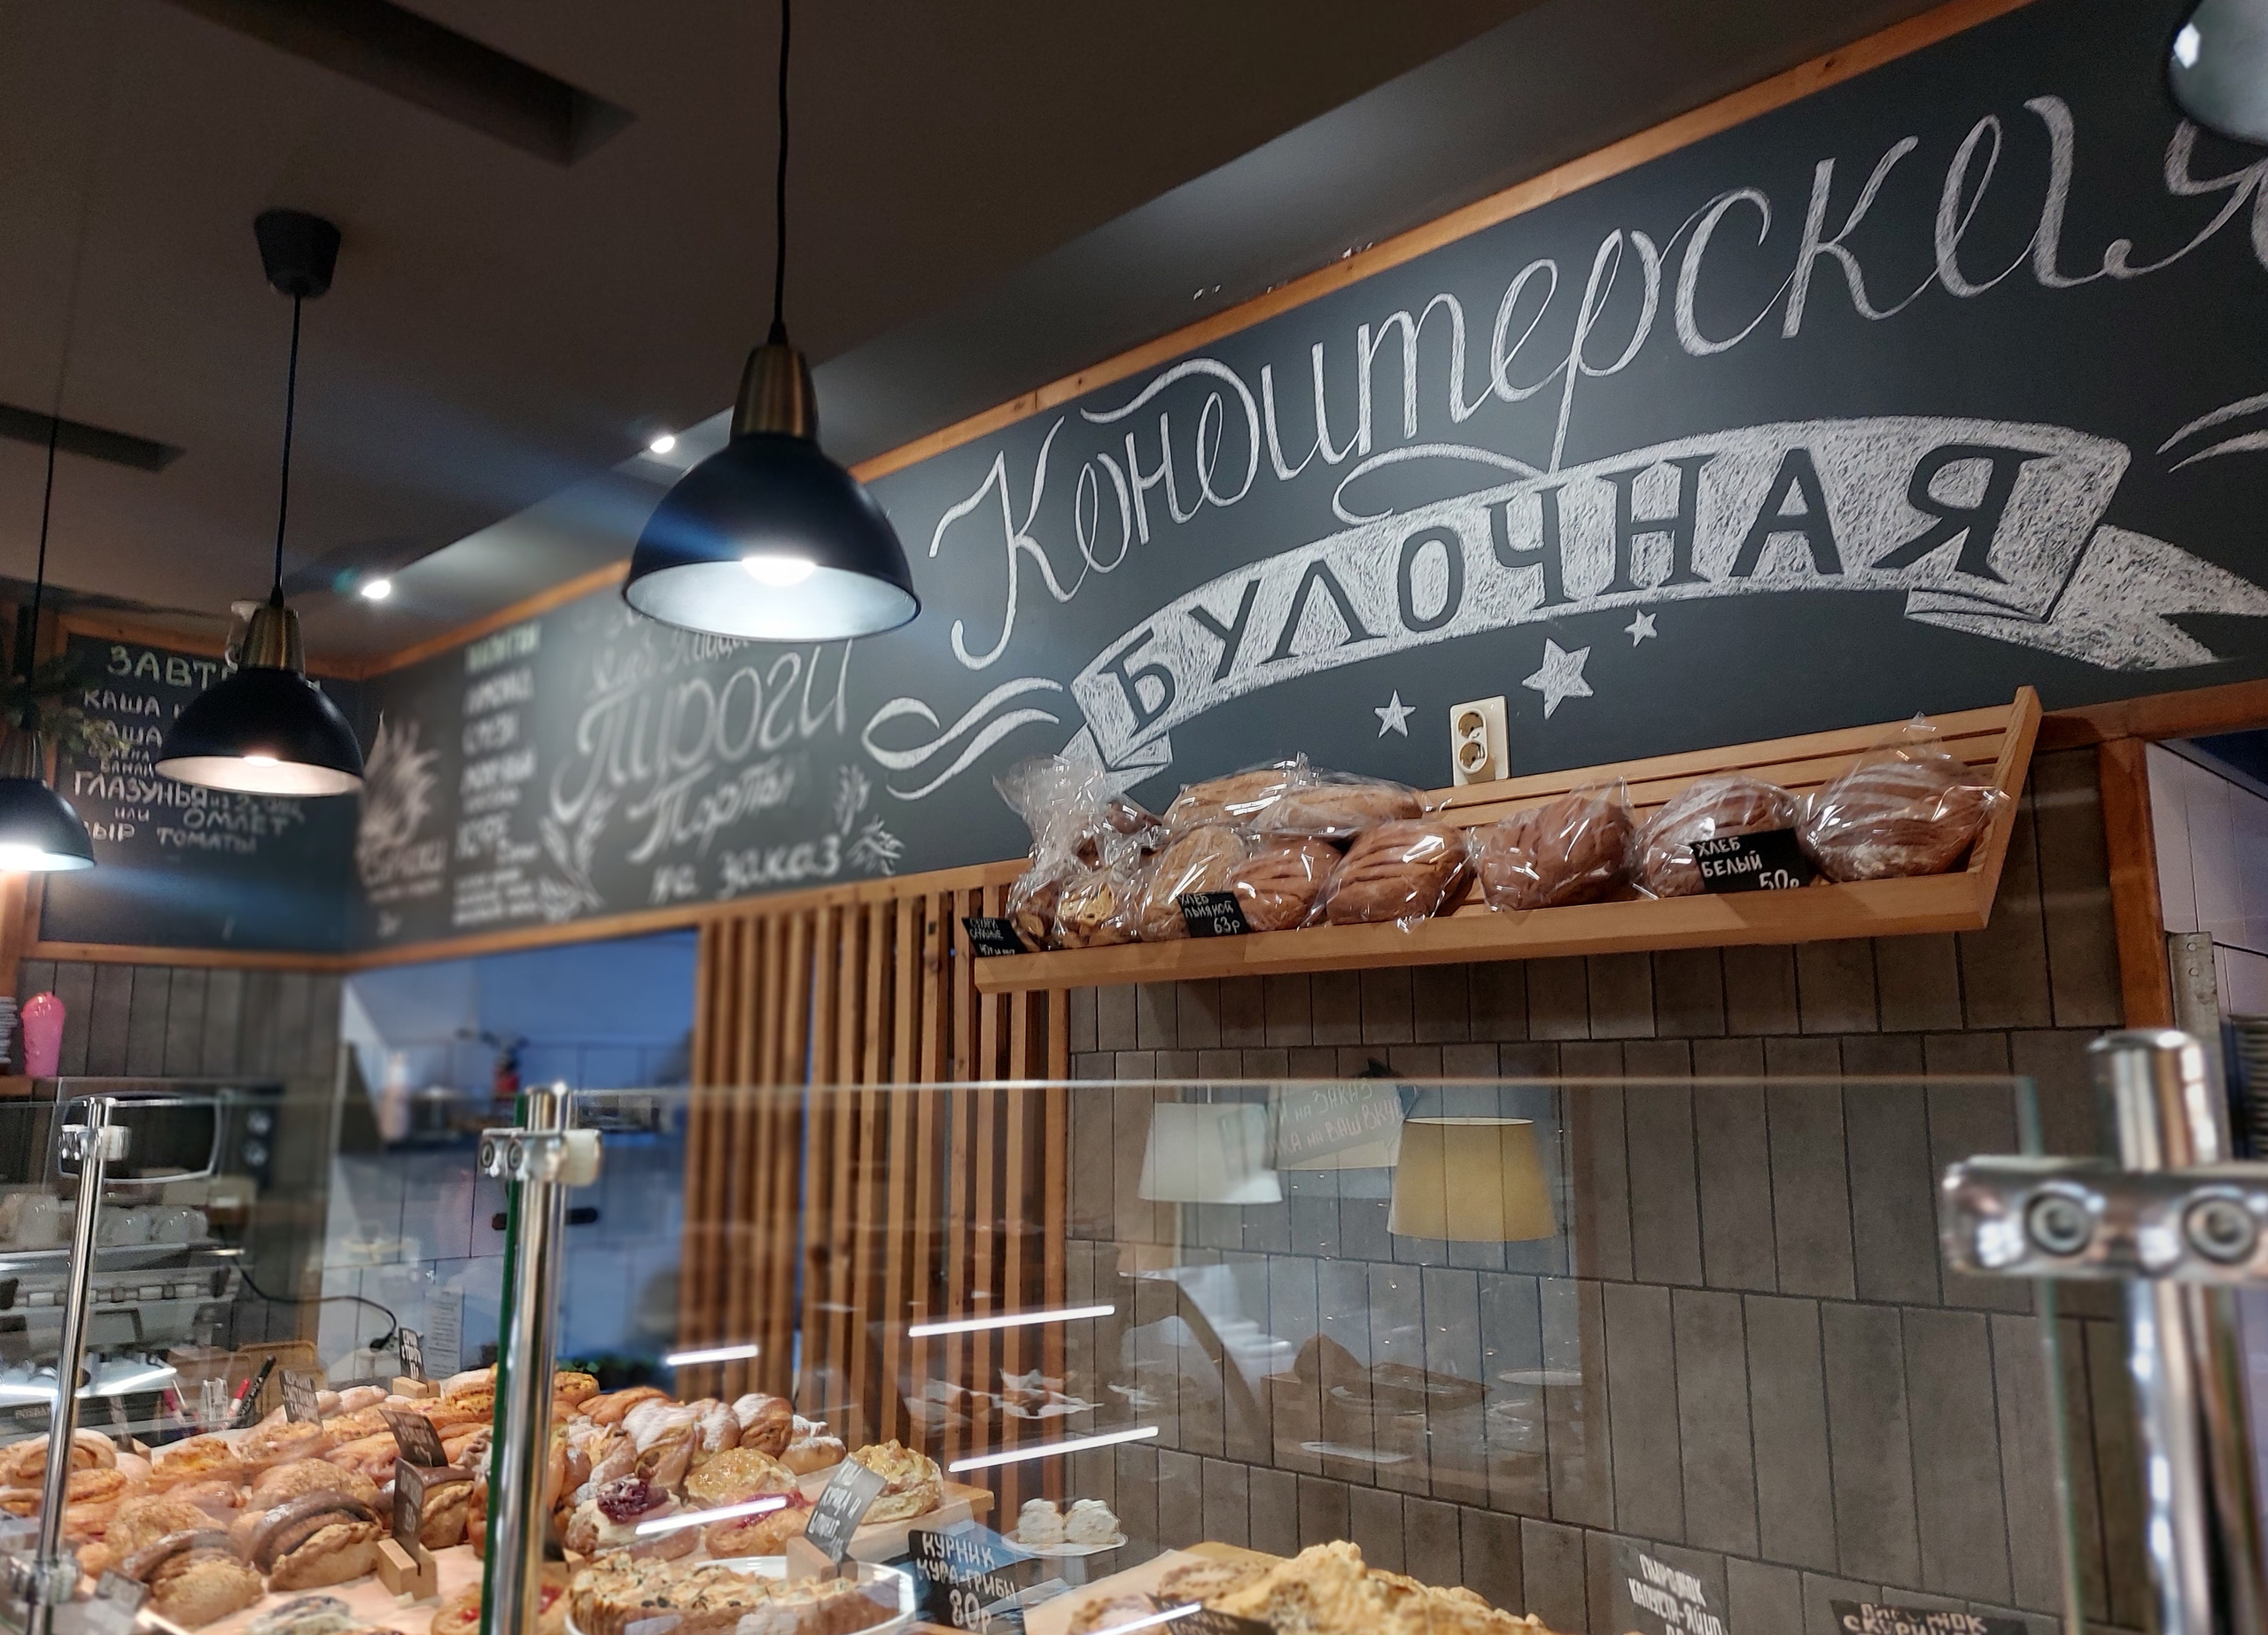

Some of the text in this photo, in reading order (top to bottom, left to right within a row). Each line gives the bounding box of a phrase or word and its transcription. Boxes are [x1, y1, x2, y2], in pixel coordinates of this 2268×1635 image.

[1099, 442, 2061, 733] БУЛОЧНАЯ
[84, 688, 160, 718] КАША
[84, 719, 162, 748] АША
[74, 771, 207, 809] ГЛАЗУНЬЯ
[84, 821, 257, 855] ЫР ТОМАТЫ
[1695, 836, 1741, 857] ХЛЕБ
[1701, 850, 1763, 878] БЕЛЫЙ
[1179, 894, 1209, 906] ХЛЕБ
[922, 1532, 996, 1570] КУРНИК
[916, 1557, 1017, 1604] КУРА-ГРИБЫ
[1639, 1554, 1706, 1608] ПИРОЖОК
